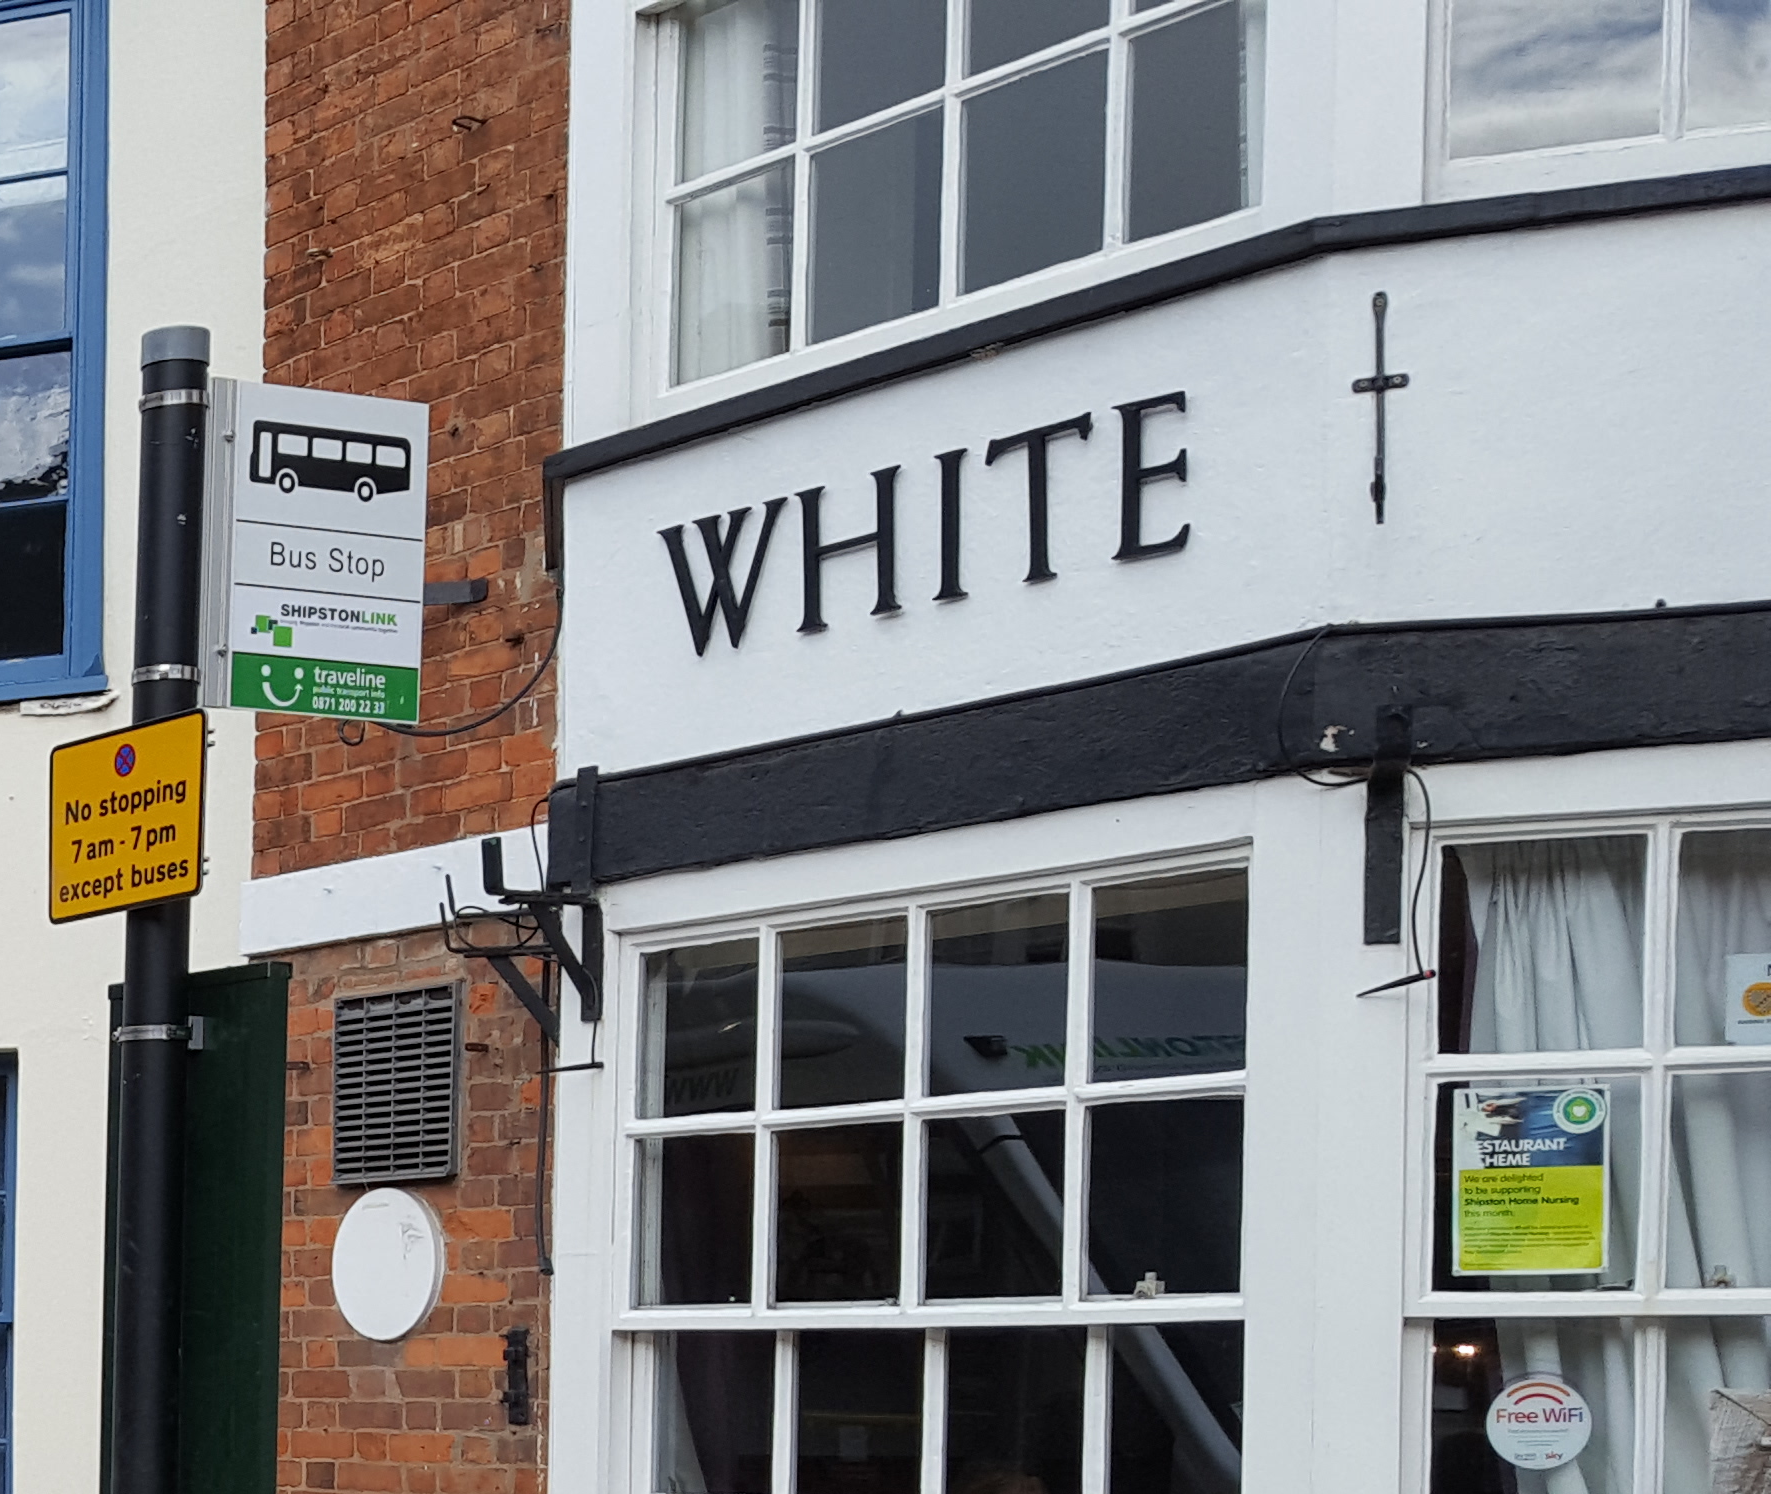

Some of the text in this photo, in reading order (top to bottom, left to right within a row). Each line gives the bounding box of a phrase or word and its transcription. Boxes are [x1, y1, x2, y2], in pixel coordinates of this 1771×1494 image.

[657, 389, 1192, 657] WHITE
[270, 541, 385, 583] Bus Stop
[280, 603, 398, 627] SHIPSTONLINK
[313, 666, 386, 689] traveline
[64, 779, 187, 826] No stopping
[59, 859, 189, 904] except buses
[1499, 1173, 1544, 1183] delighted
[1490, 1185, 1542, 1195] supporting
[1541, 1196, 1580, 1205] Nursing
[1495, 1406, 1584, 1424] Free WiFi
